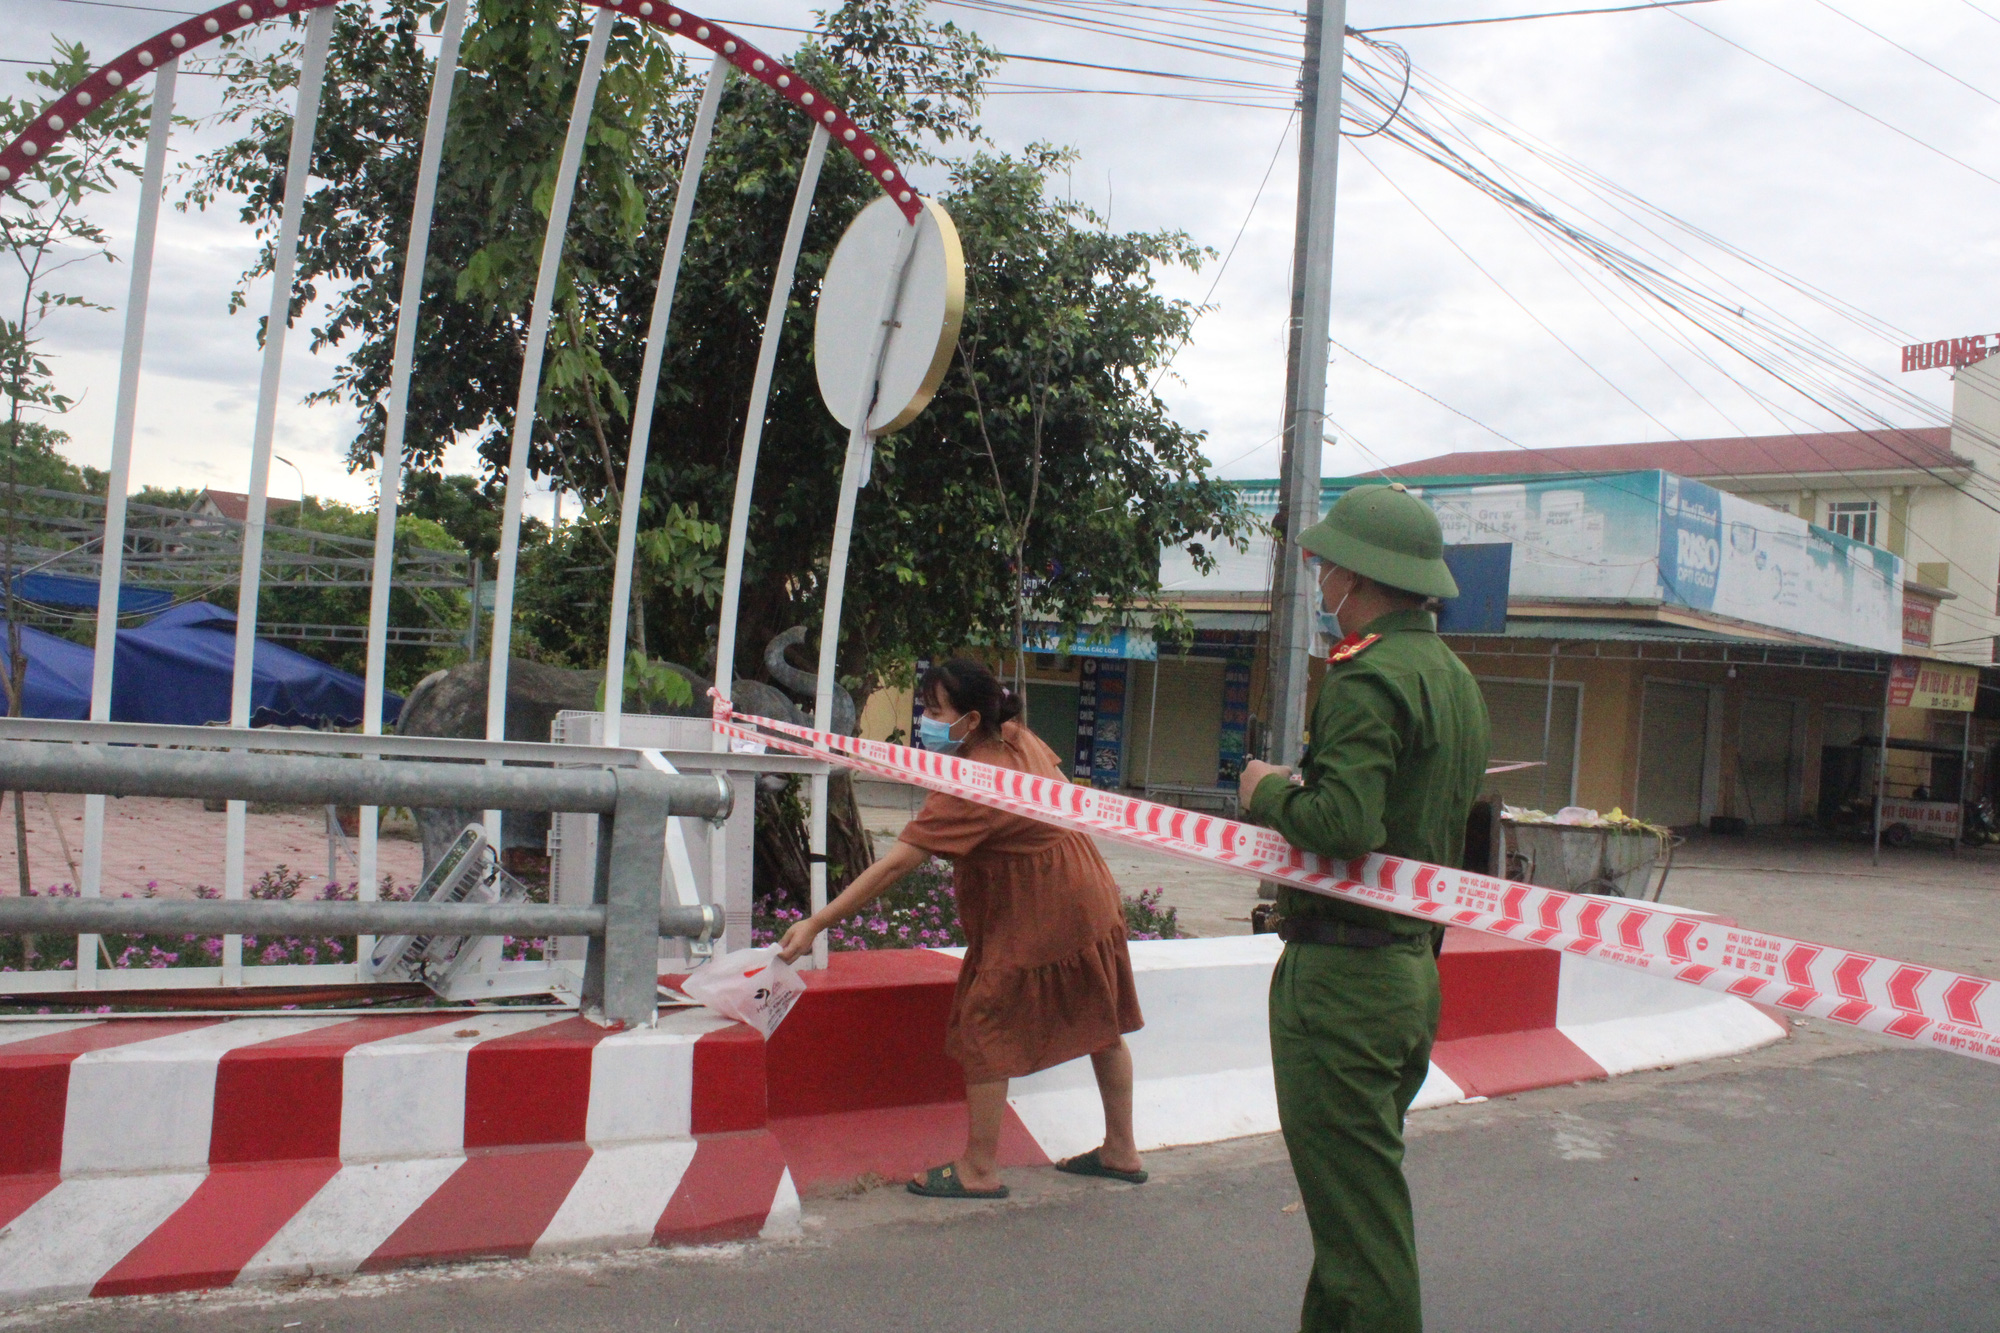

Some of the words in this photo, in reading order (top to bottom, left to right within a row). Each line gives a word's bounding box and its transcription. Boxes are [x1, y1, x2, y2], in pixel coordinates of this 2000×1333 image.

[1677, 528, 1719, 573] RISO
[1694, 571, 1715, 588] GOLD
[1727, 932, 1739, 942] KHU
[1725, 944, 1736, 953] NOT
[1737, 947, 1762, 959] ALLOWED
[1764, 952, 1778, 963] AREA
[1938, 1022, 1957, 1032] AREA
[1958, 1027, 1991, 1040] ALLOWED
